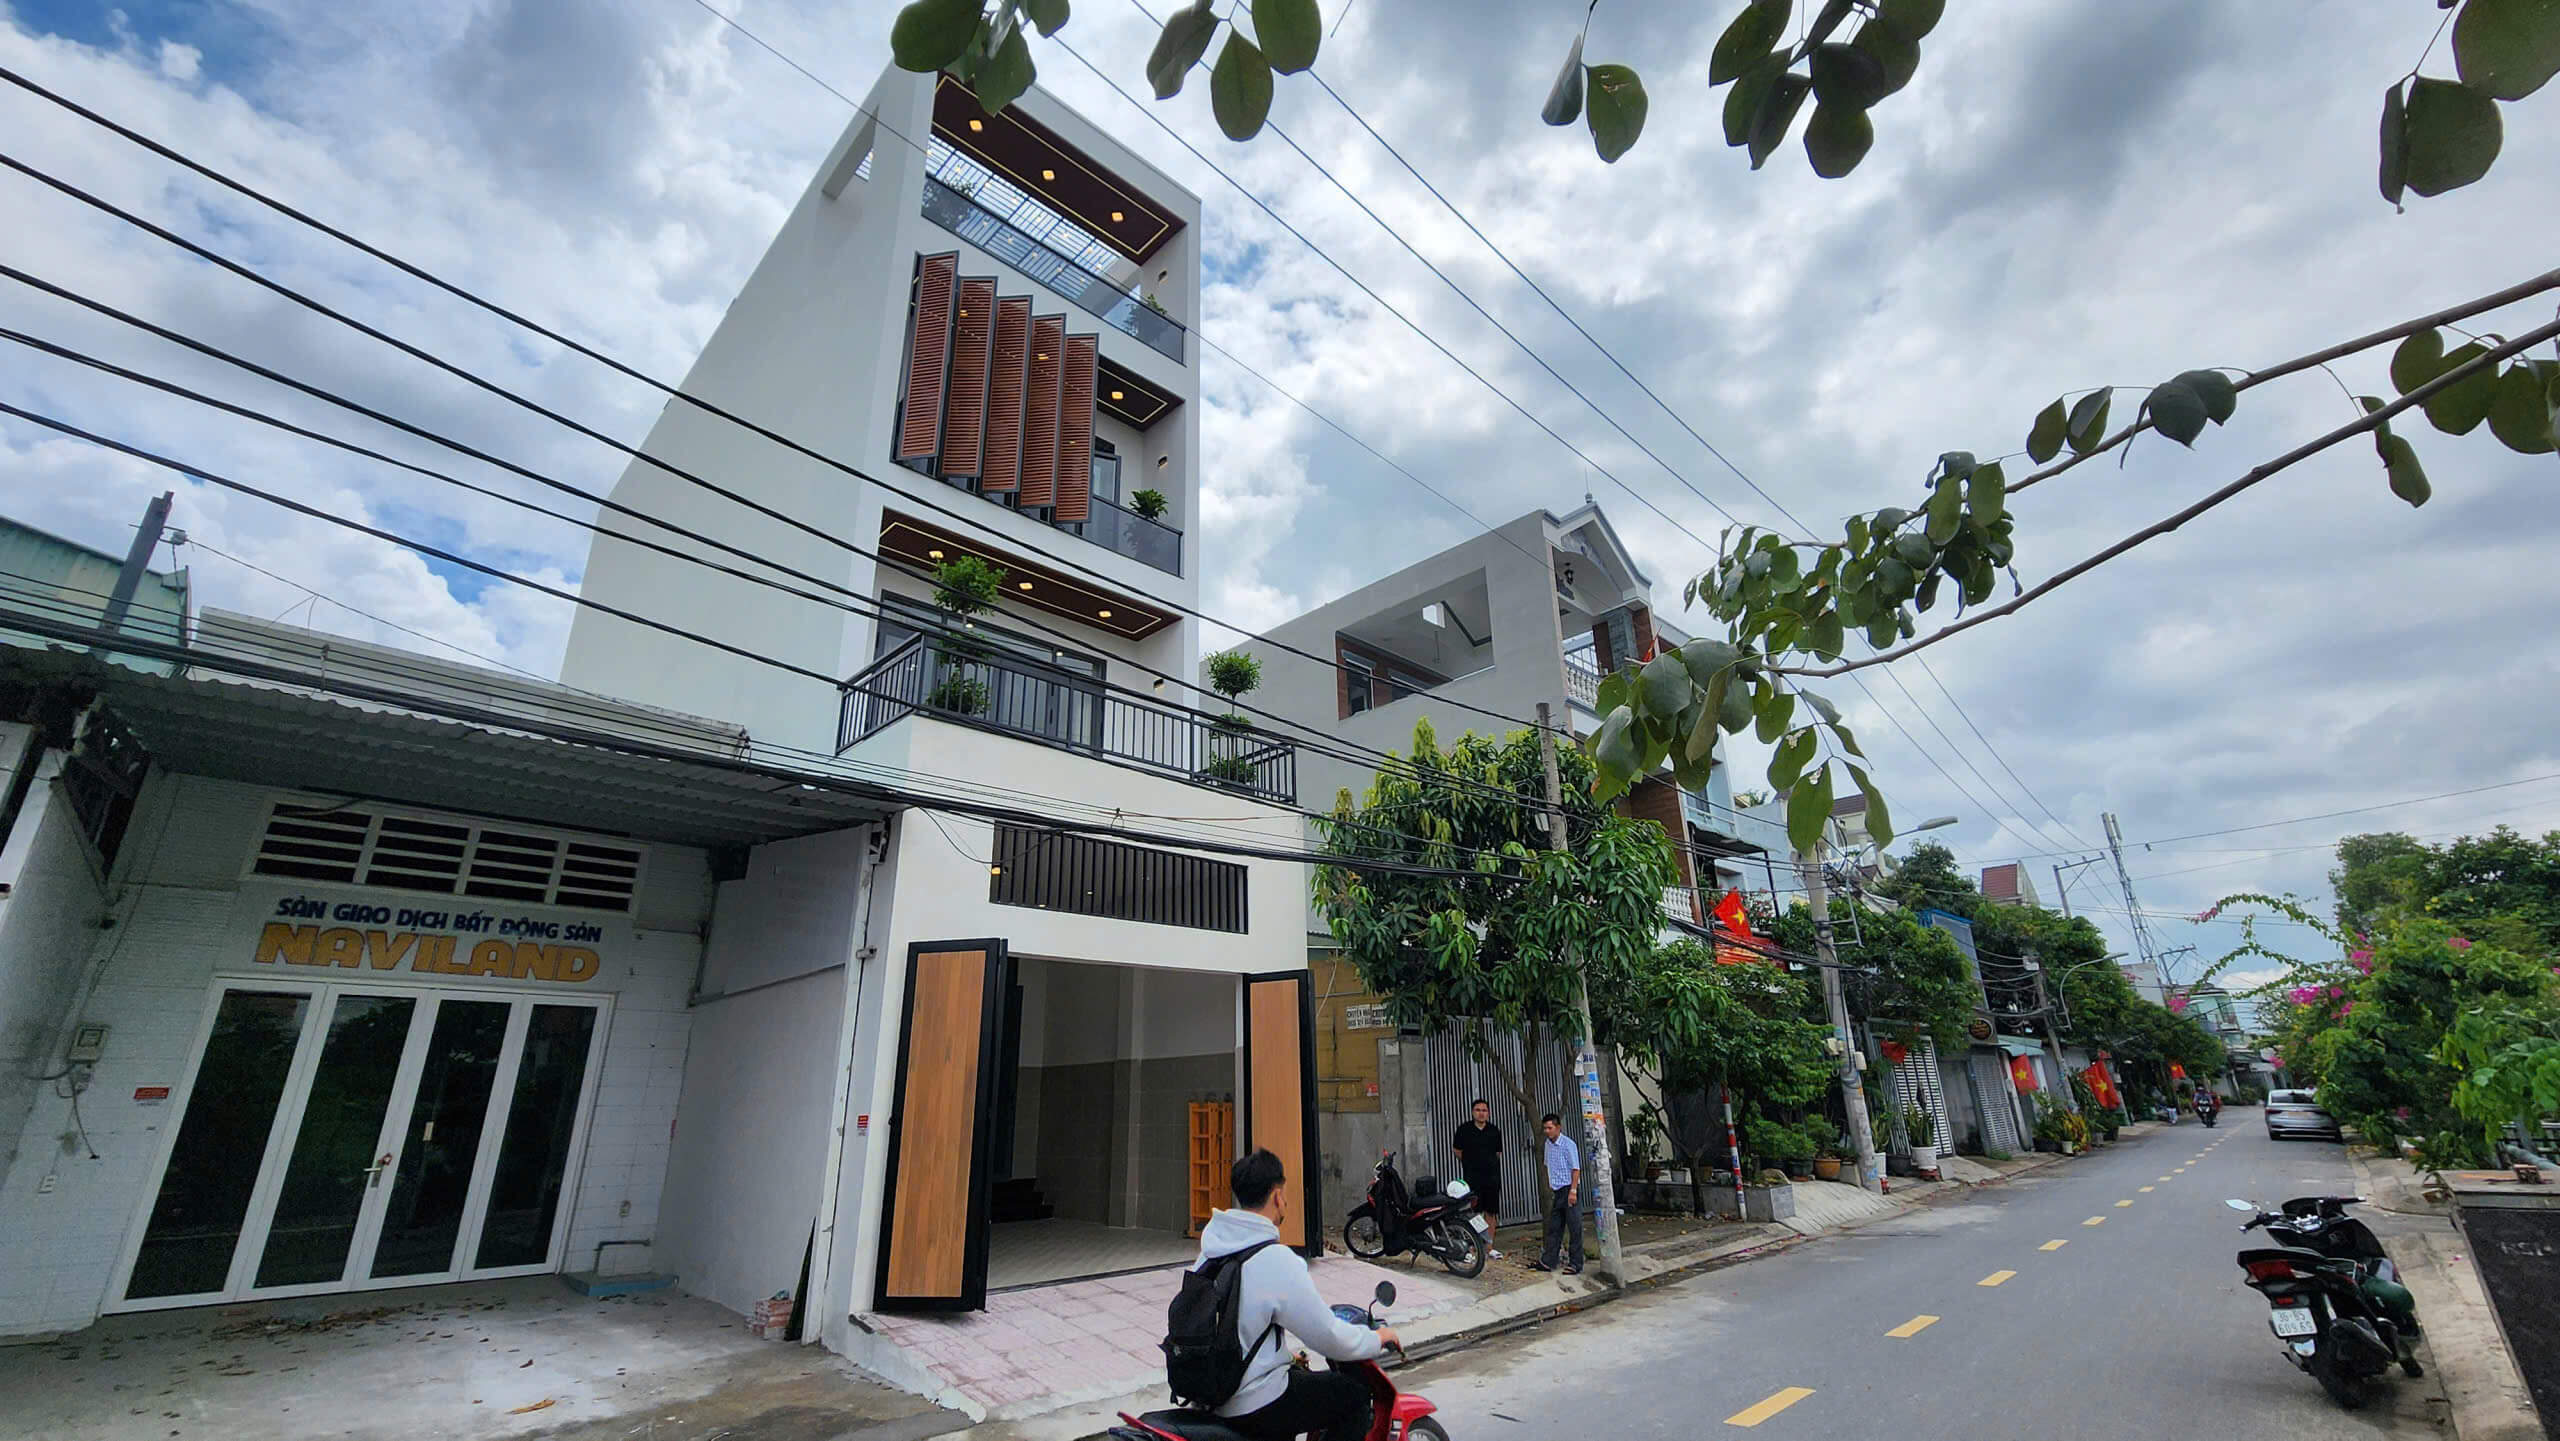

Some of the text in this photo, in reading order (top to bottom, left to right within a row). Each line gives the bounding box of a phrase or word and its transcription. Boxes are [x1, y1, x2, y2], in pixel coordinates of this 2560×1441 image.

[276, 896, 328, 919] SÀN
[333, 903, 391, 924] GIAO
[396, 908, 449, 931] DỊCH
[453, 910, 495, 932] BẤT
[499, 917, 560, 940] ĐỘNG
[254, 922, 600, 982] NAVILAND
